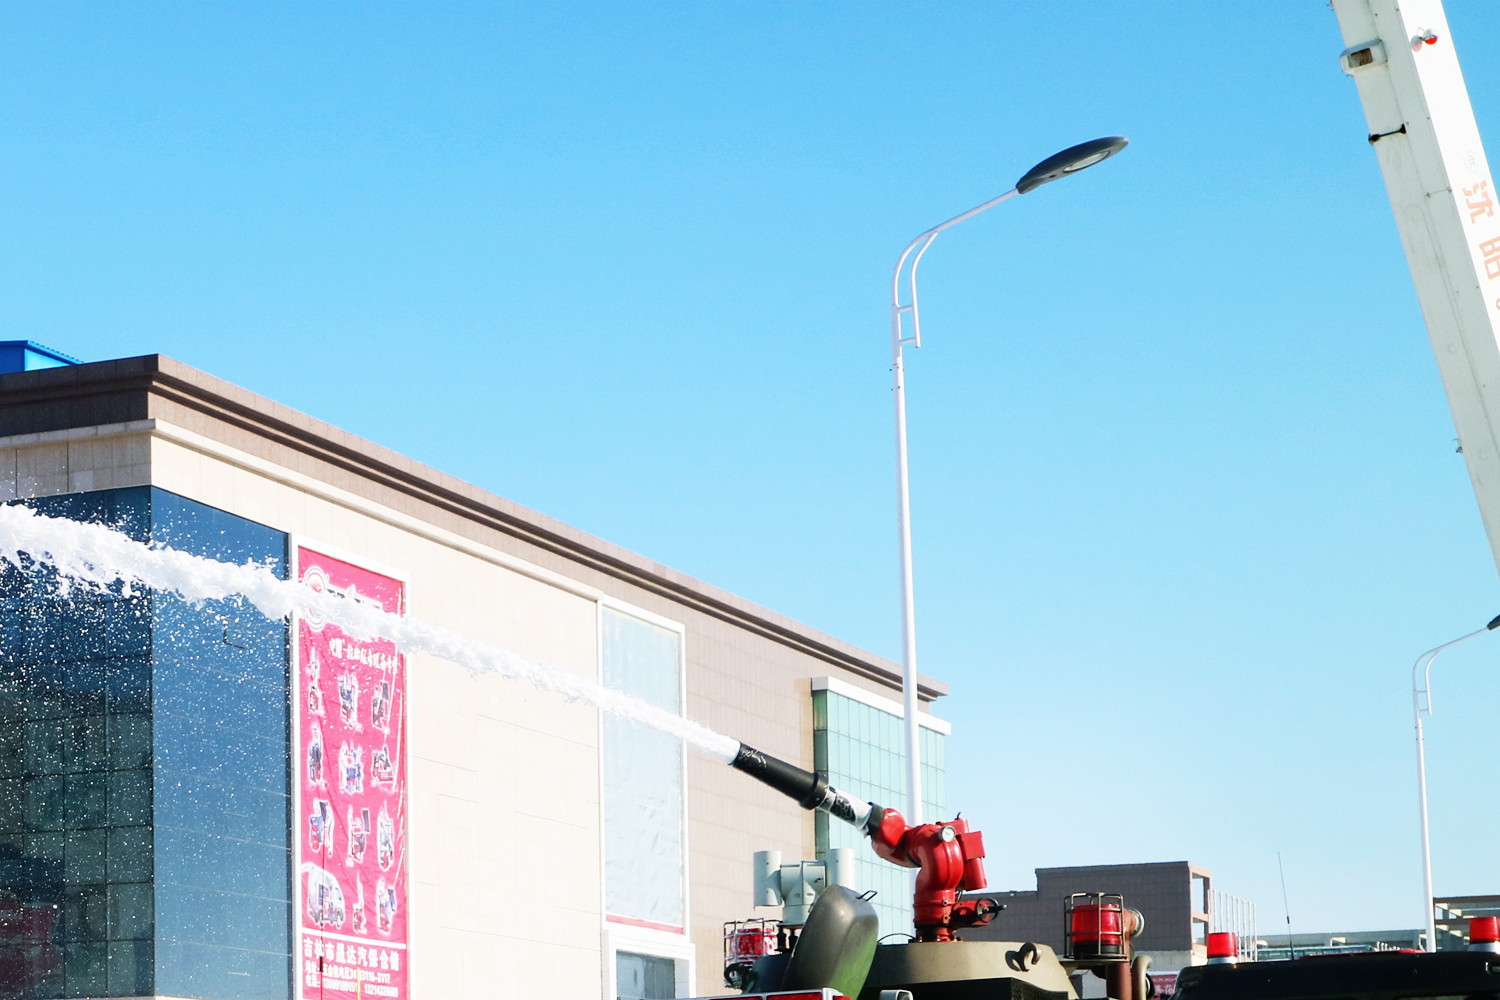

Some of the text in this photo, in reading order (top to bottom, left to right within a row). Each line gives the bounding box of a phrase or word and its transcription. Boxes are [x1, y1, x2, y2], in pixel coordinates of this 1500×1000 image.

[304, 937, 399, 971] 吉林市晟达汽保仓储
